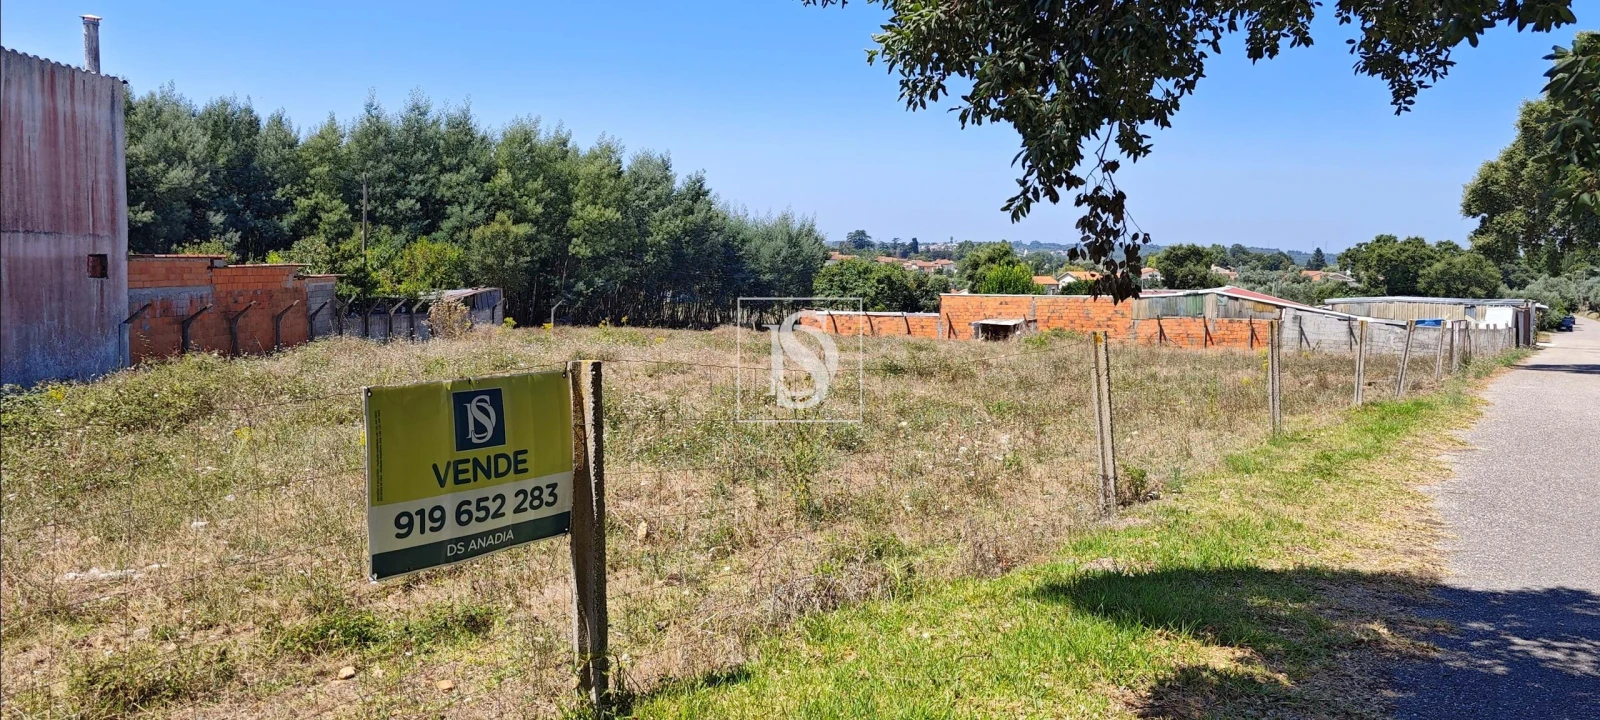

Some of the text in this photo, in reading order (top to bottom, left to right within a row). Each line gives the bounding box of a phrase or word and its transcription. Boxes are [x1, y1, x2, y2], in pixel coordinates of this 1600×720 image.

[432, 449, 529, 488] VENDE
[394, 482, 558, 539] 919 652 283
[447, 529, 514, 557] DS ANADIA
